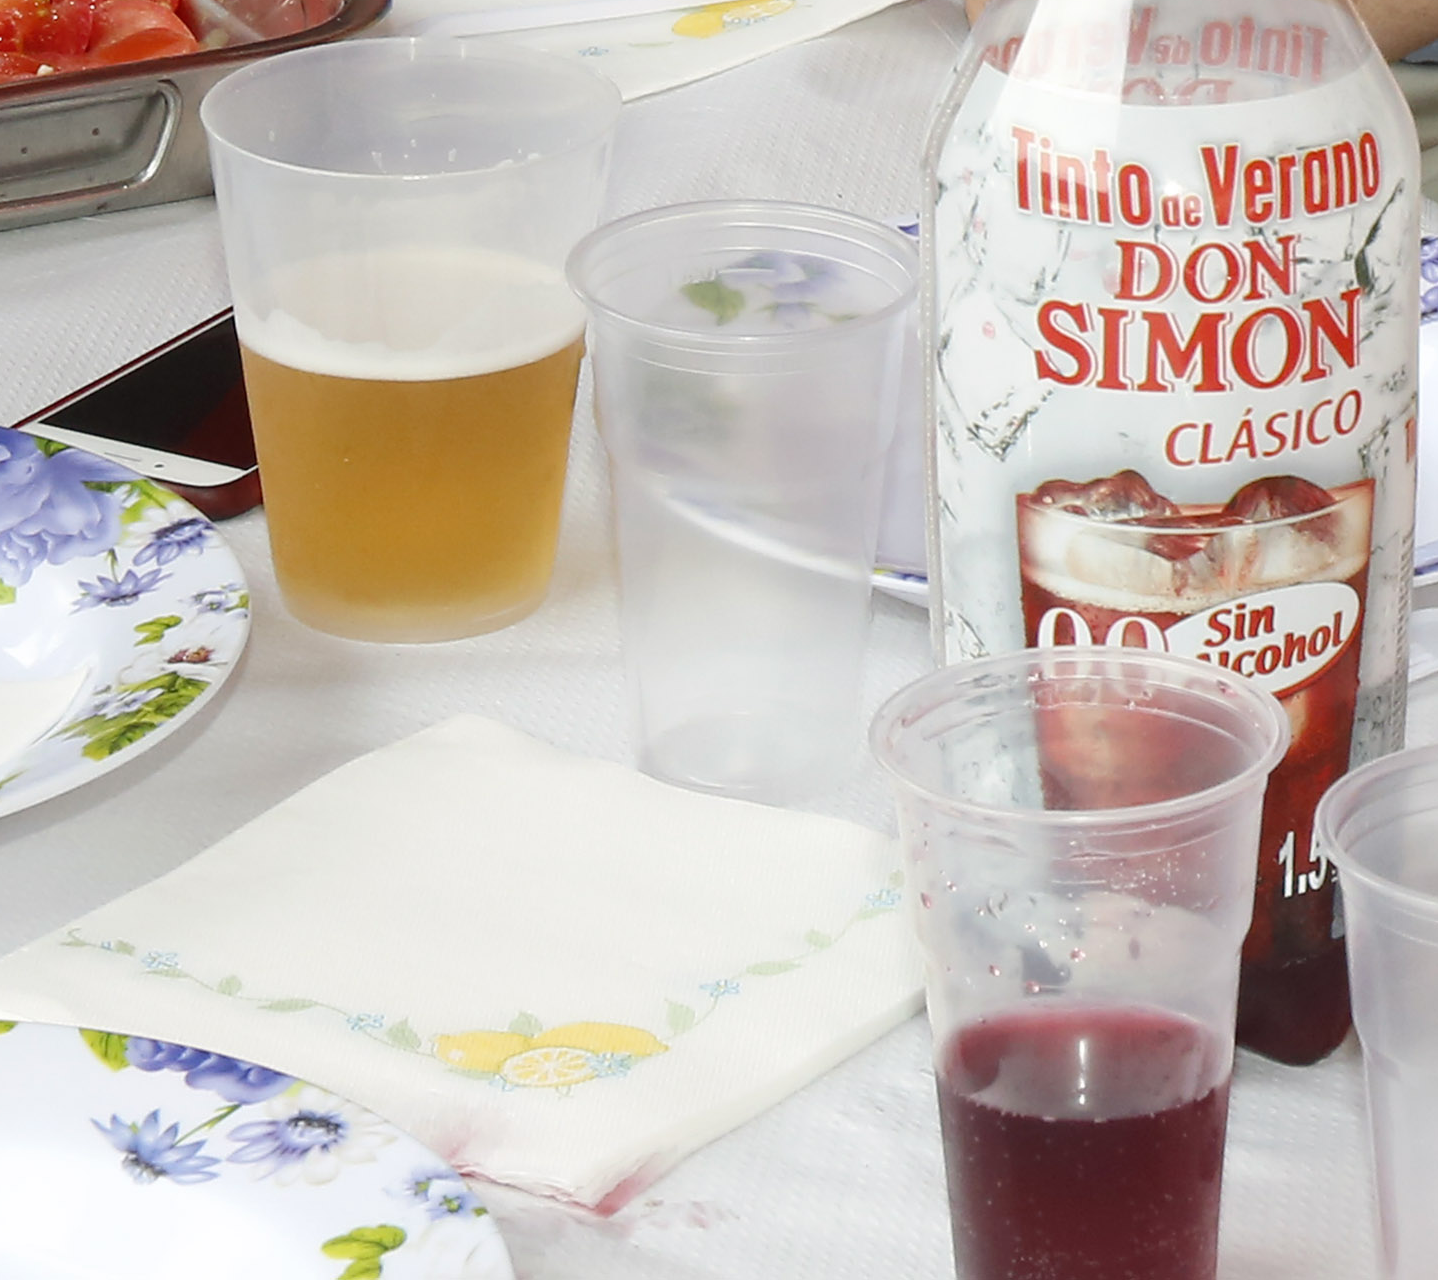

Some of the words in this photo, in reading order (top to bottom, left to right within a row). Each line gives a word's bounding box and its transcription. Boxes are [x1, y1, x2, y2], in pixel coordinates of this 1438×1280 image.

[1009, 123, 1154, 229] Tinto
[1198, 129, 1382, 229] Verano
[1113, 234, 1298, 306] DON
[1034, 287, 1363, 394] SIMON
[1163, 385, 1363, 469] CLÁSICO
[1195, 609, 1345, 679] lcohol
[1203, 601, 1276, 648] Sin
